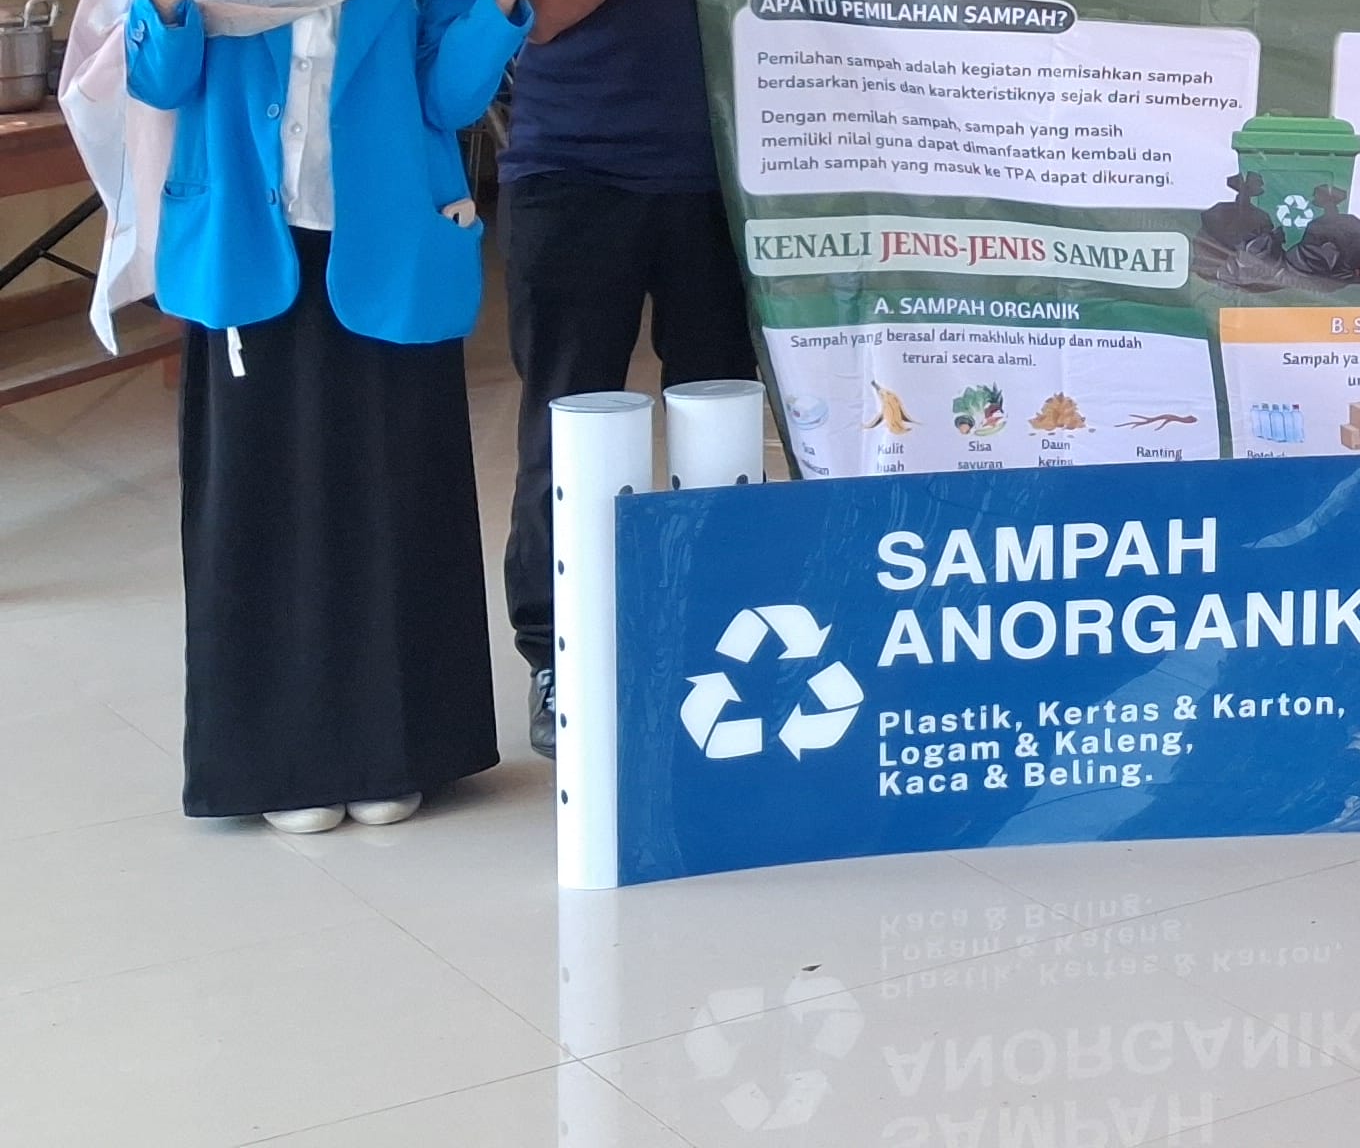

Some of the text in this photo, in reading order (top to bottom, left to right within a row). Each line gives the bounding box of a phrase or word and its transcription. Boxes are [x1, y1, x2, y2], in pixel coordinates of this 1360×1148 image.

[841, 1, 959, 25] PEMILAHAN
[963, 5, 1068, 28] SAMPAH?
[757, 51, 1213, 87] Pemilahan sampah adalah kegiatan memisahkan sampah
[757, 76, 1244, 111] berdasarkan jenis dan karakteristiknya sejak dari sumbernya.
[753, 230, 1176, 273] KENALI JENIS-JENIS SAMPAH
[874, 297, 1081, 322] A. SAMPAH ORGANIK
[1331, 317, 1349, 335] B.
[790, 327, 1142, 352] Sampah yang berasal dari makhluk hidup dan mudah
[1282, 350, 1340, 368] Sampah
[877, 441, 905, 457] Kulit
[967, 439, 993, 453] Sisa
[1040, 439, 1073, 452] Daun
[1135, 445, 1183, 463] Ranting
[876, 516, 1218, 592] SAMPAH
[879, 692, 1346, 738] Plastik, Kertas & Karton,
[880, 727, 1194, 771] Logam & Kaleng,
[879, 758, 1154, 797] Kaca & Beling.
